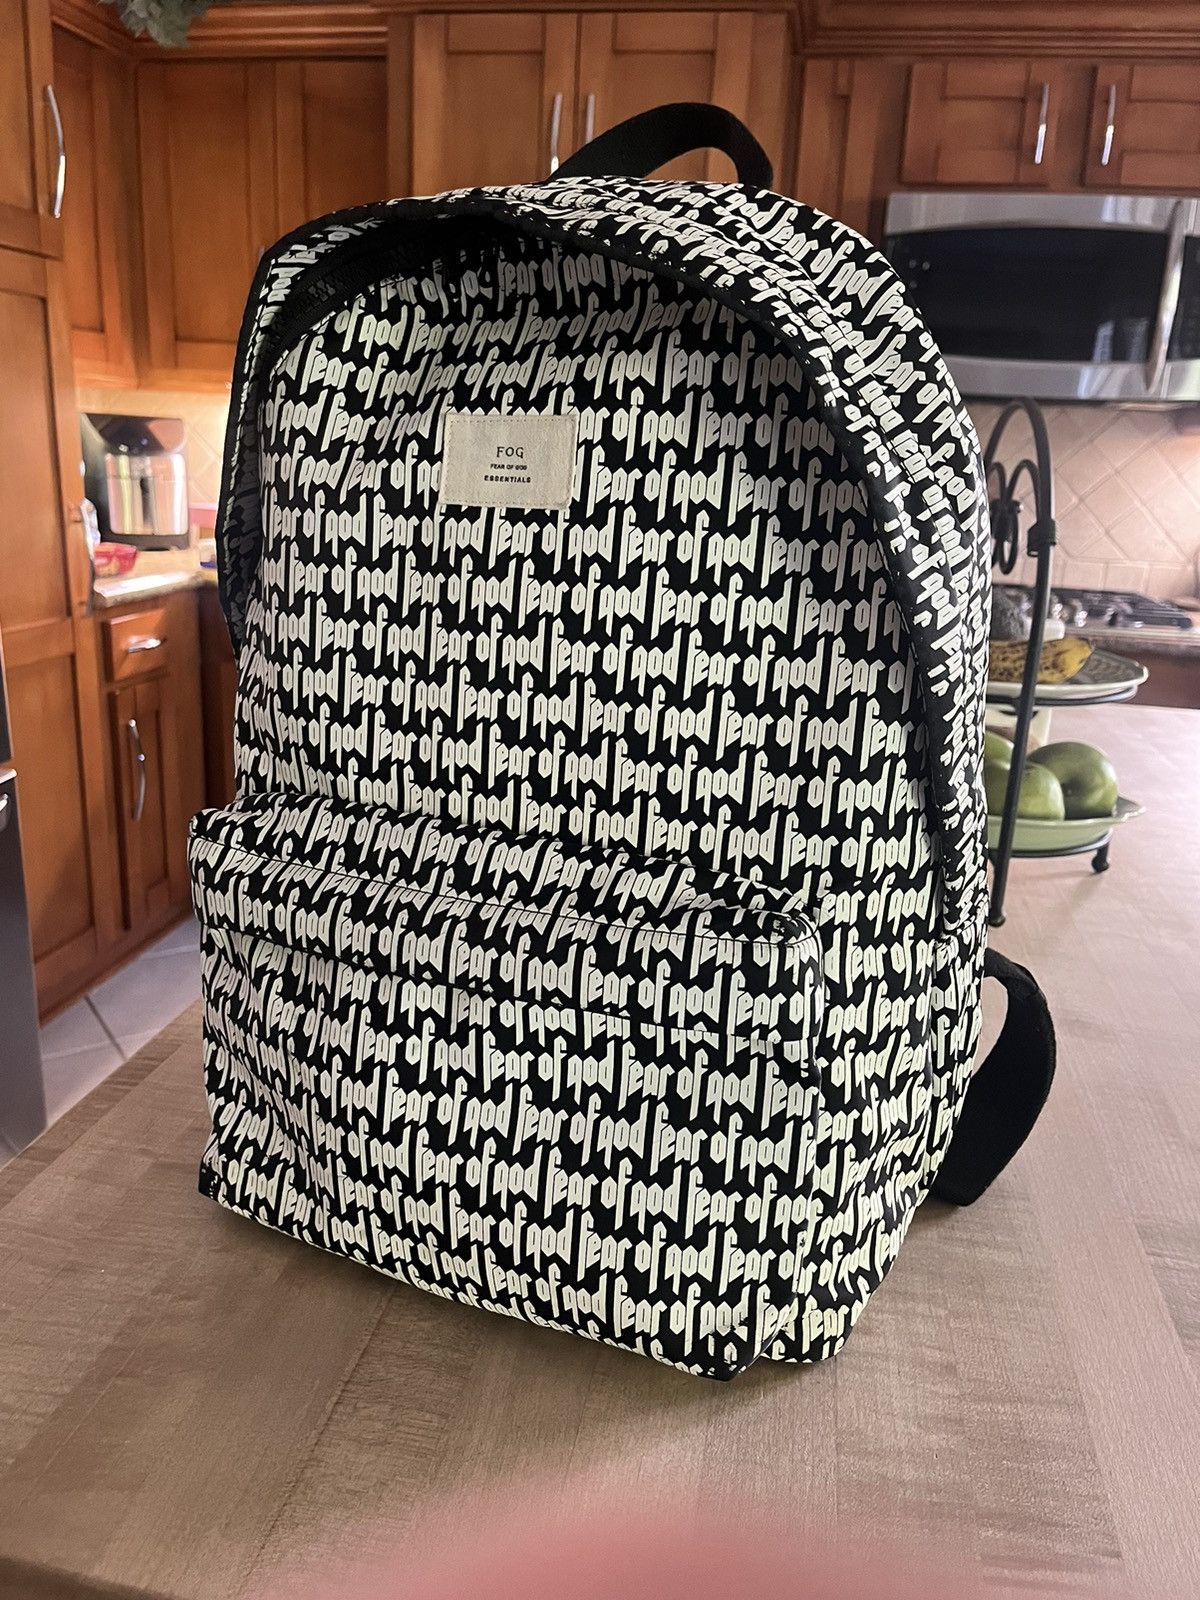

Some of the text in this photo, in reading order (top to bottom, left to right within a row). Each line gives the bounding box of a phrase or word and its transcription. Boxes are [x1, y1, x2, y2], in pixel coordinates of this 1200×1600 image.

[266, 380, 286, 446] of
[320, 392, 376, 452] fear
[374, 399, 404, 454] of
[300, 334, 356, 395] fear
[356, 351, 389, 410] of
[416, 352, 467, 406] fear
[464, 346, 499, 401] of
[529, 342, 584, 401] fear
[584, 336, 618, 400] of
[662, 330, 720, 404] fear
[722, 330, 755, 404] of
[496, 446, 524, 458] FOG
[612, 387, 644, 461] of
[694, 391, 753, 464] fear
[484, 475, 531, 483] ESSENTIALS
[586, 445, 642, 518] fear
[644, 449, 676, 522] of
[727, 451, 786, 527] fear
[788, 457, 821, 531] of
[269, 487, 301, 552] fear
[303, 490, 325, 556] of
[372, 493, 419, 561] fear
[618, 506, 675, 579] fear
[677, 510, 709, 584] of
[761, 515, 820, 589] fear
[266, 592, 278, 654] of
[315, 597, 360, 662] fear
[362, 603, 388, 669] of
[429, 608, 474, 675] fear
[476, 613, 502, 682] of
[550, 618, 600, 688] fear
[602, 624, 633, 694] of
[683, 629, 741, 700] fear
[743, 634, 775, 706] of
[826, 637, 885, 709] fear
[274, 694, 306, 753] fear
[309, 702, 330, 764] of
[373, 709, 417, 773] fear
[420, 716, 442, 781] of
[488, 723, 536, 789] fear
[538, 730, 565, 797] of
[613, 738, 665, 805] fear
[667, 745, 698, 813] of
[749, 750, 806, 821] fear
[807, 756, 840, 828] of
[238, 877, 273, 931] fear
[275, 887, 300, 945] of
[335, 898, 378, 957] fear
[378, 909, 408, 972] of
[449, 921, 498, 984] fear
[500, 933, 531, 997] of
[580, 946, 635, 1012] fear
[638, 959, 670, 1024] of
[727, 970, 786, 1034] fear
[266, 977, 305, 1038] fear
[303, 992, 324, 1057] of
[356, 1006, 403, 1073] fear
[406, 1017, 435, 1084] of
[483, 1030, 535, 1093] fear
[538, 1036, 567, 1101] of
[618, 1041, 675, 1111] fear
[677, 1048, 708, 1121] of
[761, 1060, 820, 1131] fear
[312, 1097, 345, 1155] fear
[348, 1116, 369, 1176] of
[416, 1127, 464, 1193] fear
[466, 1137, 496, 1207] of
[544, 1146, 599, 1219] fear
[601, 1157, 632, 1230] of
[685, 1166, 743, 1239] fear
[745, 1173, 777, 1243] of
[228, 1146, 253, 1203] of
[278, 1167, 314, 1227] fear
[315, 1194, 330, 1247] of
[370, 1213, 414, 1264] fear
[417, 1232, 440, 1280] of
[484, 1248, 532, 1299] fear
[536, 1263, 560, 1318] of
[614, 1275, 667, 1338] fear
[670, 1282, 700, 1356] of
